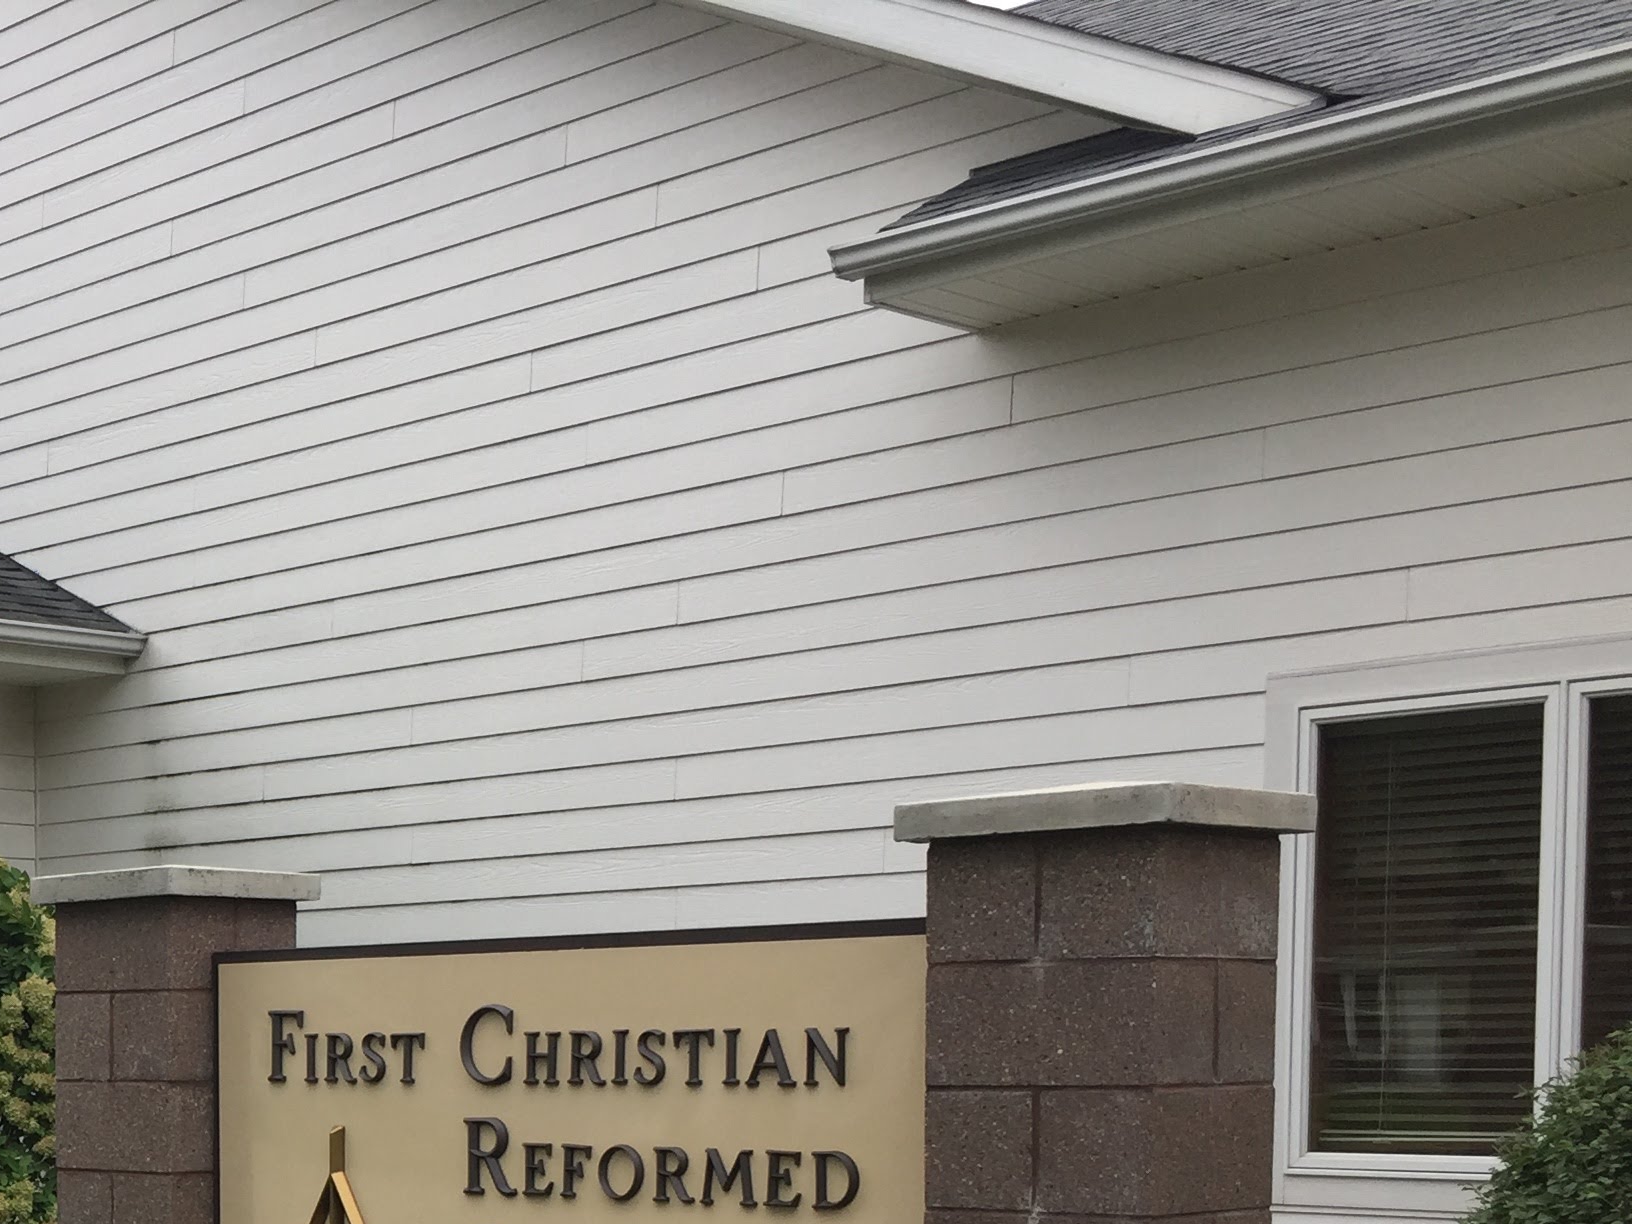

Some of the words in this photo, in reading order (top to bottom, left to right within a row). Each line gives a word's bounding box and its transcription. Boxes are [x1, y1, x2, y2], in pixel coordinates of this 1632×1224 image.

[268, 1009, 426, 1086] FIRST
[459, 1003, 850, 1088] CHRISTIAN
[463, 1116, 861, 1211] REFORMED
